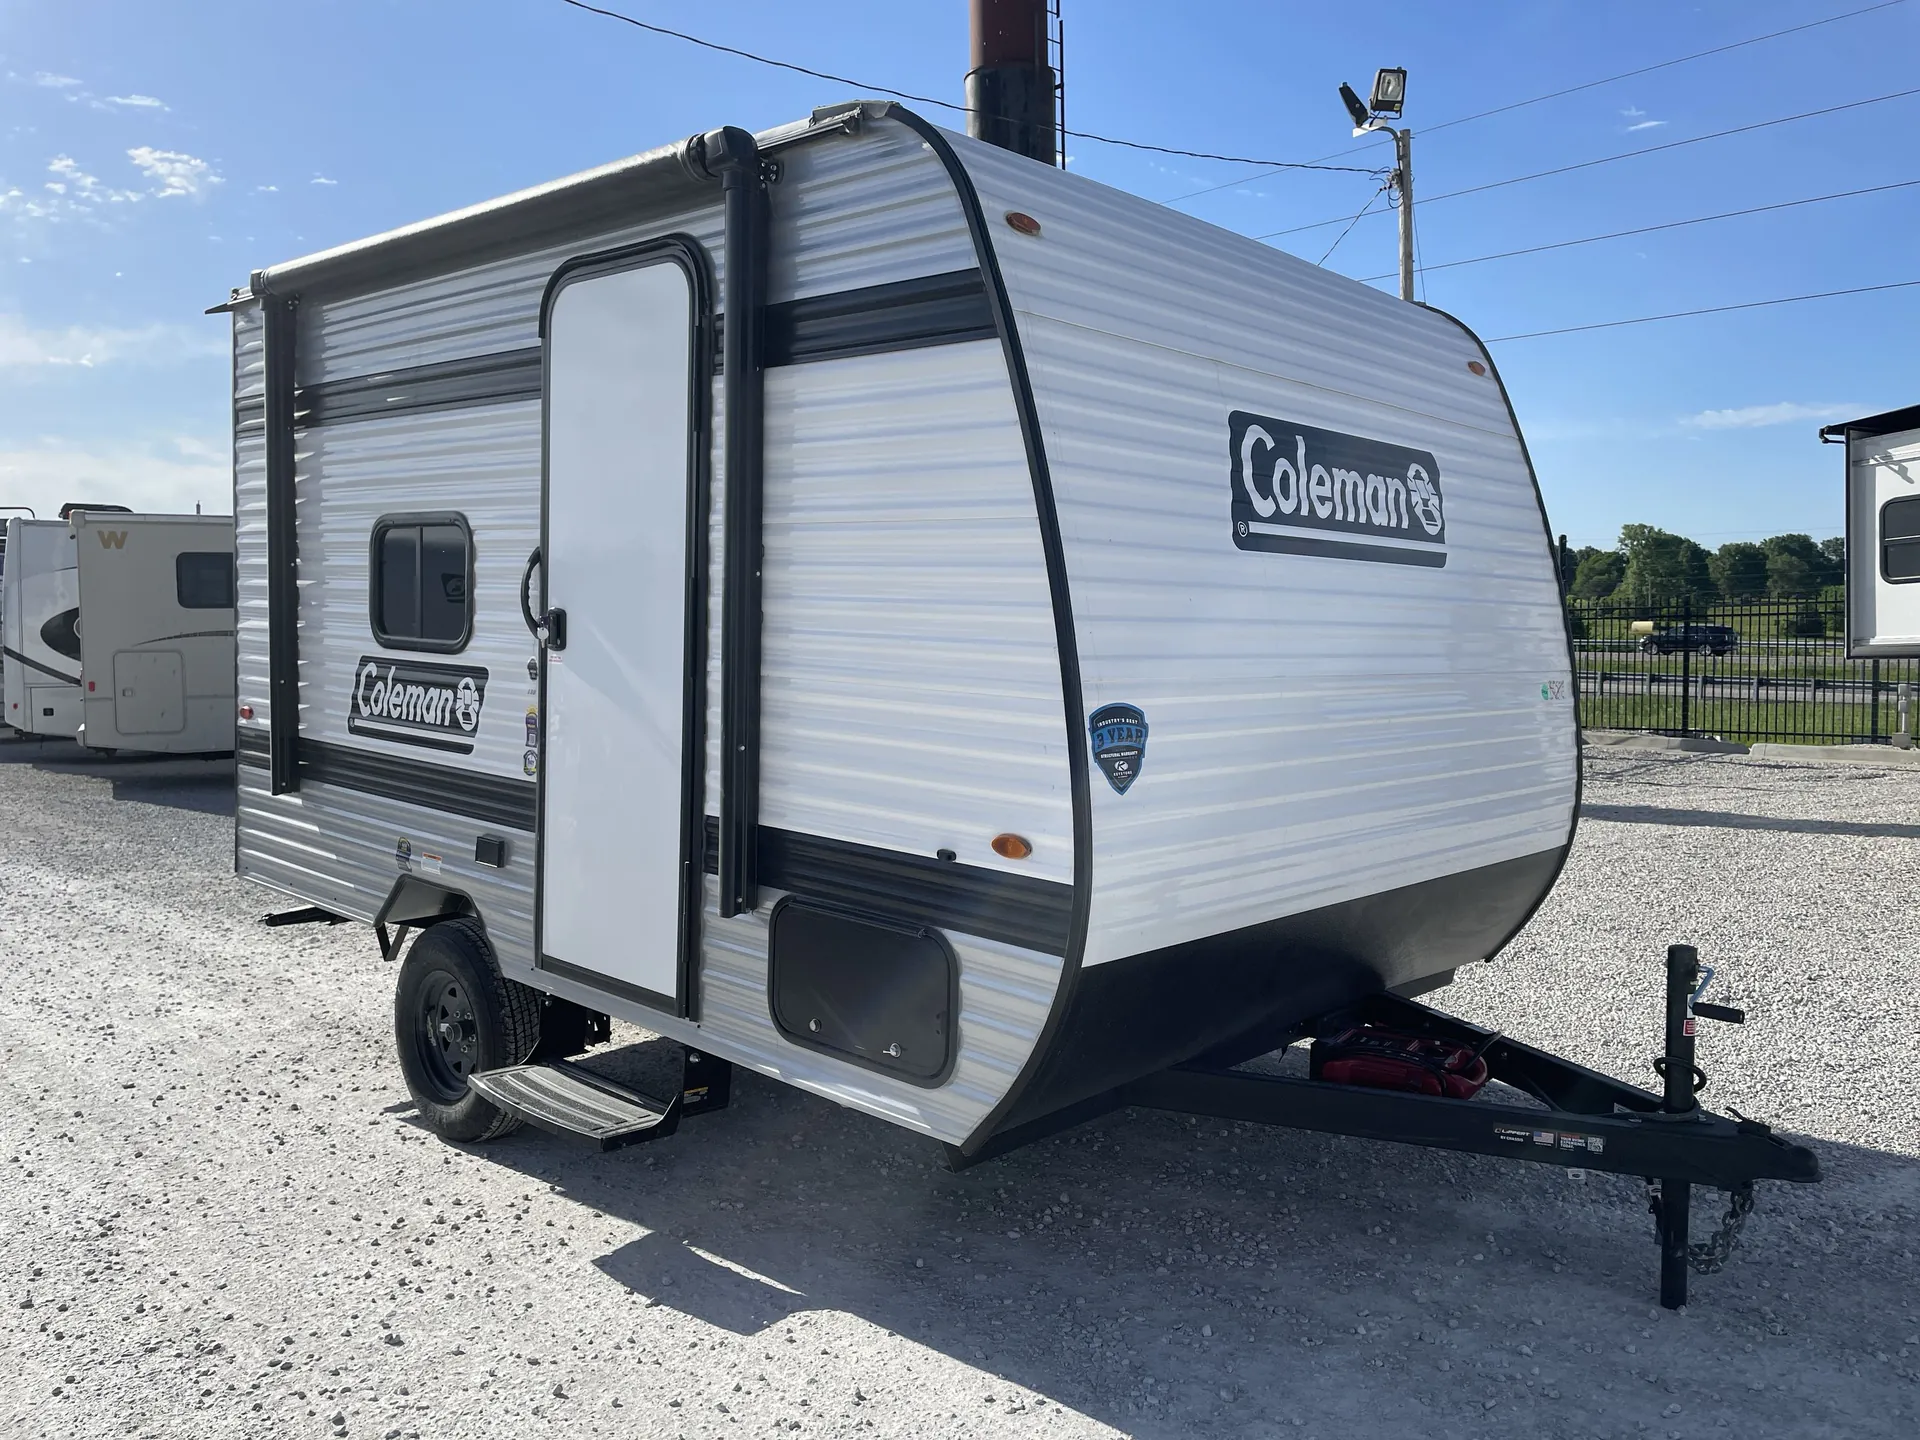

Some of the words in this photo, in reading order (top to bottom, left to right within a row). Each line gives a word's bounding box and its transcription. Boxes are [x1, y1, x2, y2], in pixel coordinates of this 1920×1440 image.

[1241, 424, 1409, 529] Coleman
[97, 530, 128, 549] W
[358, 662, 455, 726] Coleman
[1096, 733, 1104, 748] 3
[1107, 728, 1143, 743] YEAR
